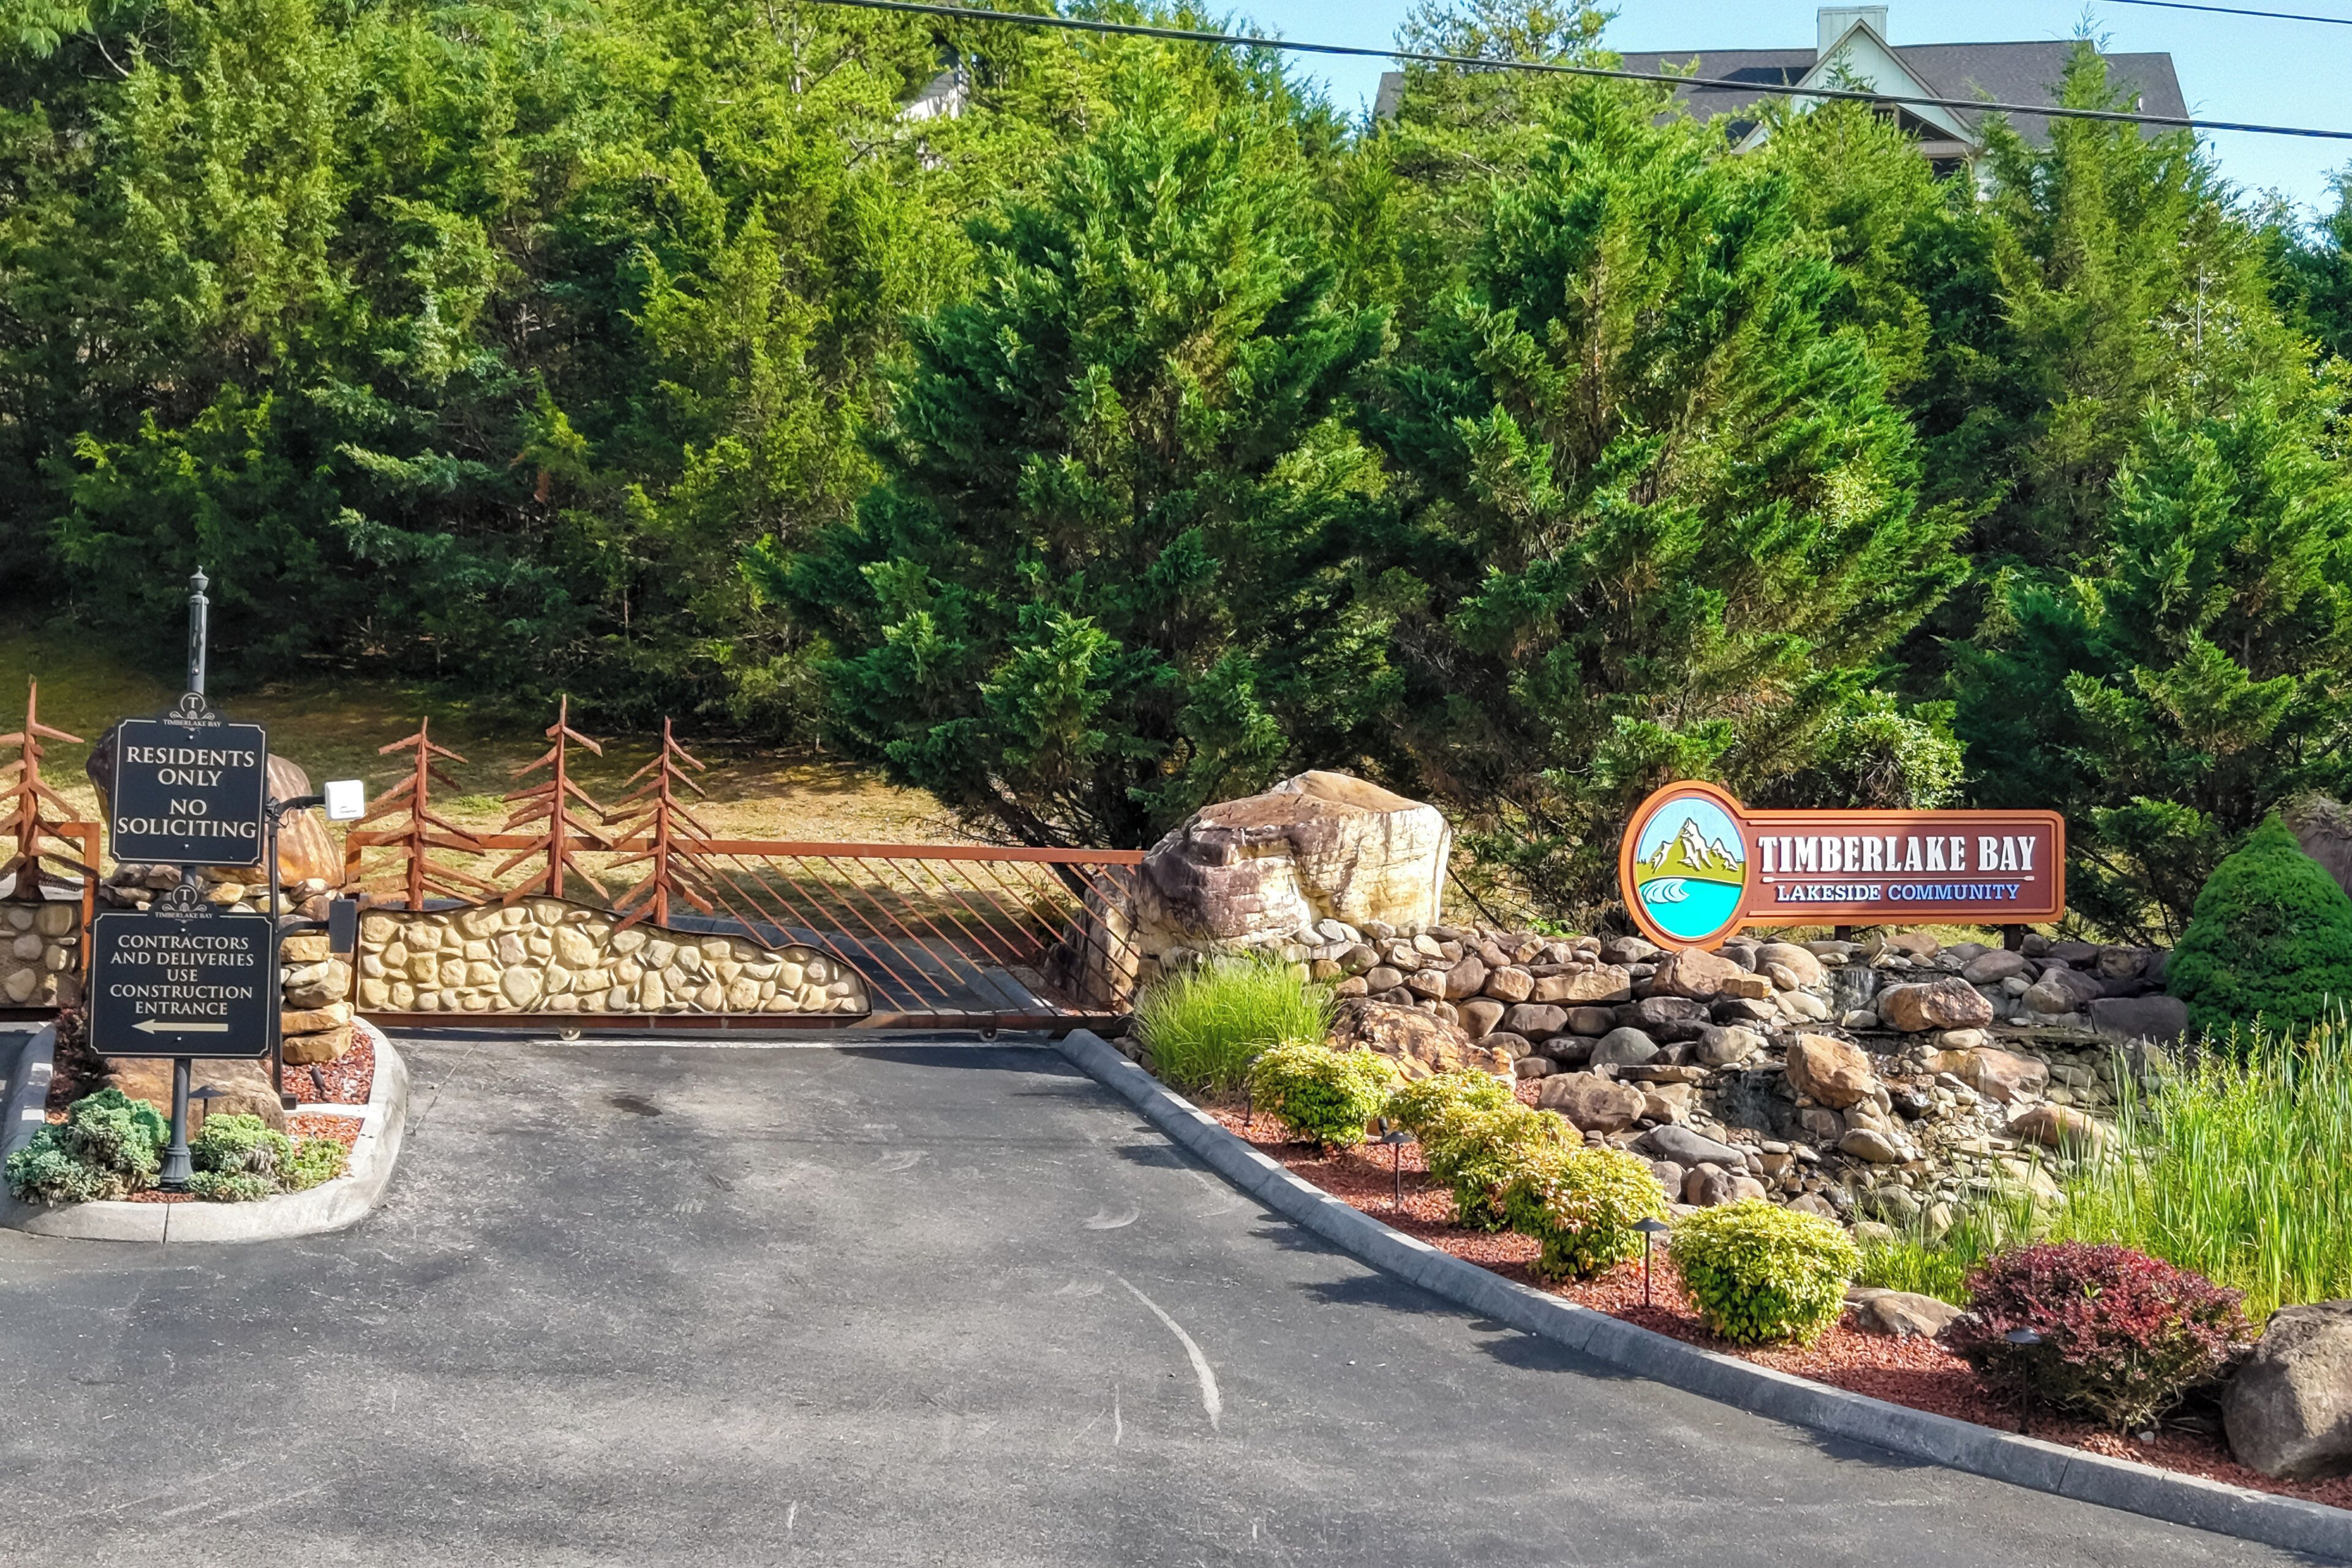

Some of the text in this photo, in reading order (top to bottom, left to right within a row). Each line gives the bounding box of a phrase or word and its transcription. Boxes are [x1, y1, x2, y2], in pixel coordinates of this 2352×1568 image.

[188, 697, 198, 709] T
[126, 746, 255, 767] RESIDENTS
[157, 768, 223, 786] ONLY
[169, 798, 207, 815] NO
[117, 817, 257, 839] SOLICITING
[1758, 836, 2037, 873] TIMBERLAKE BAY
[180, 889, 190, 901] T
[1777, 884, 2020, 902] LAKESIDE COMMUNITY
[118, 935, 249, 950] CONTRACTORS
[110, 952, 254, 967] AND DELIVERIES
[167, 969, 198, 982] USE
[110, 984, 253, 1000] CONSTRUCTION
[135, 1001, 228, 1016] ENTRANCE
